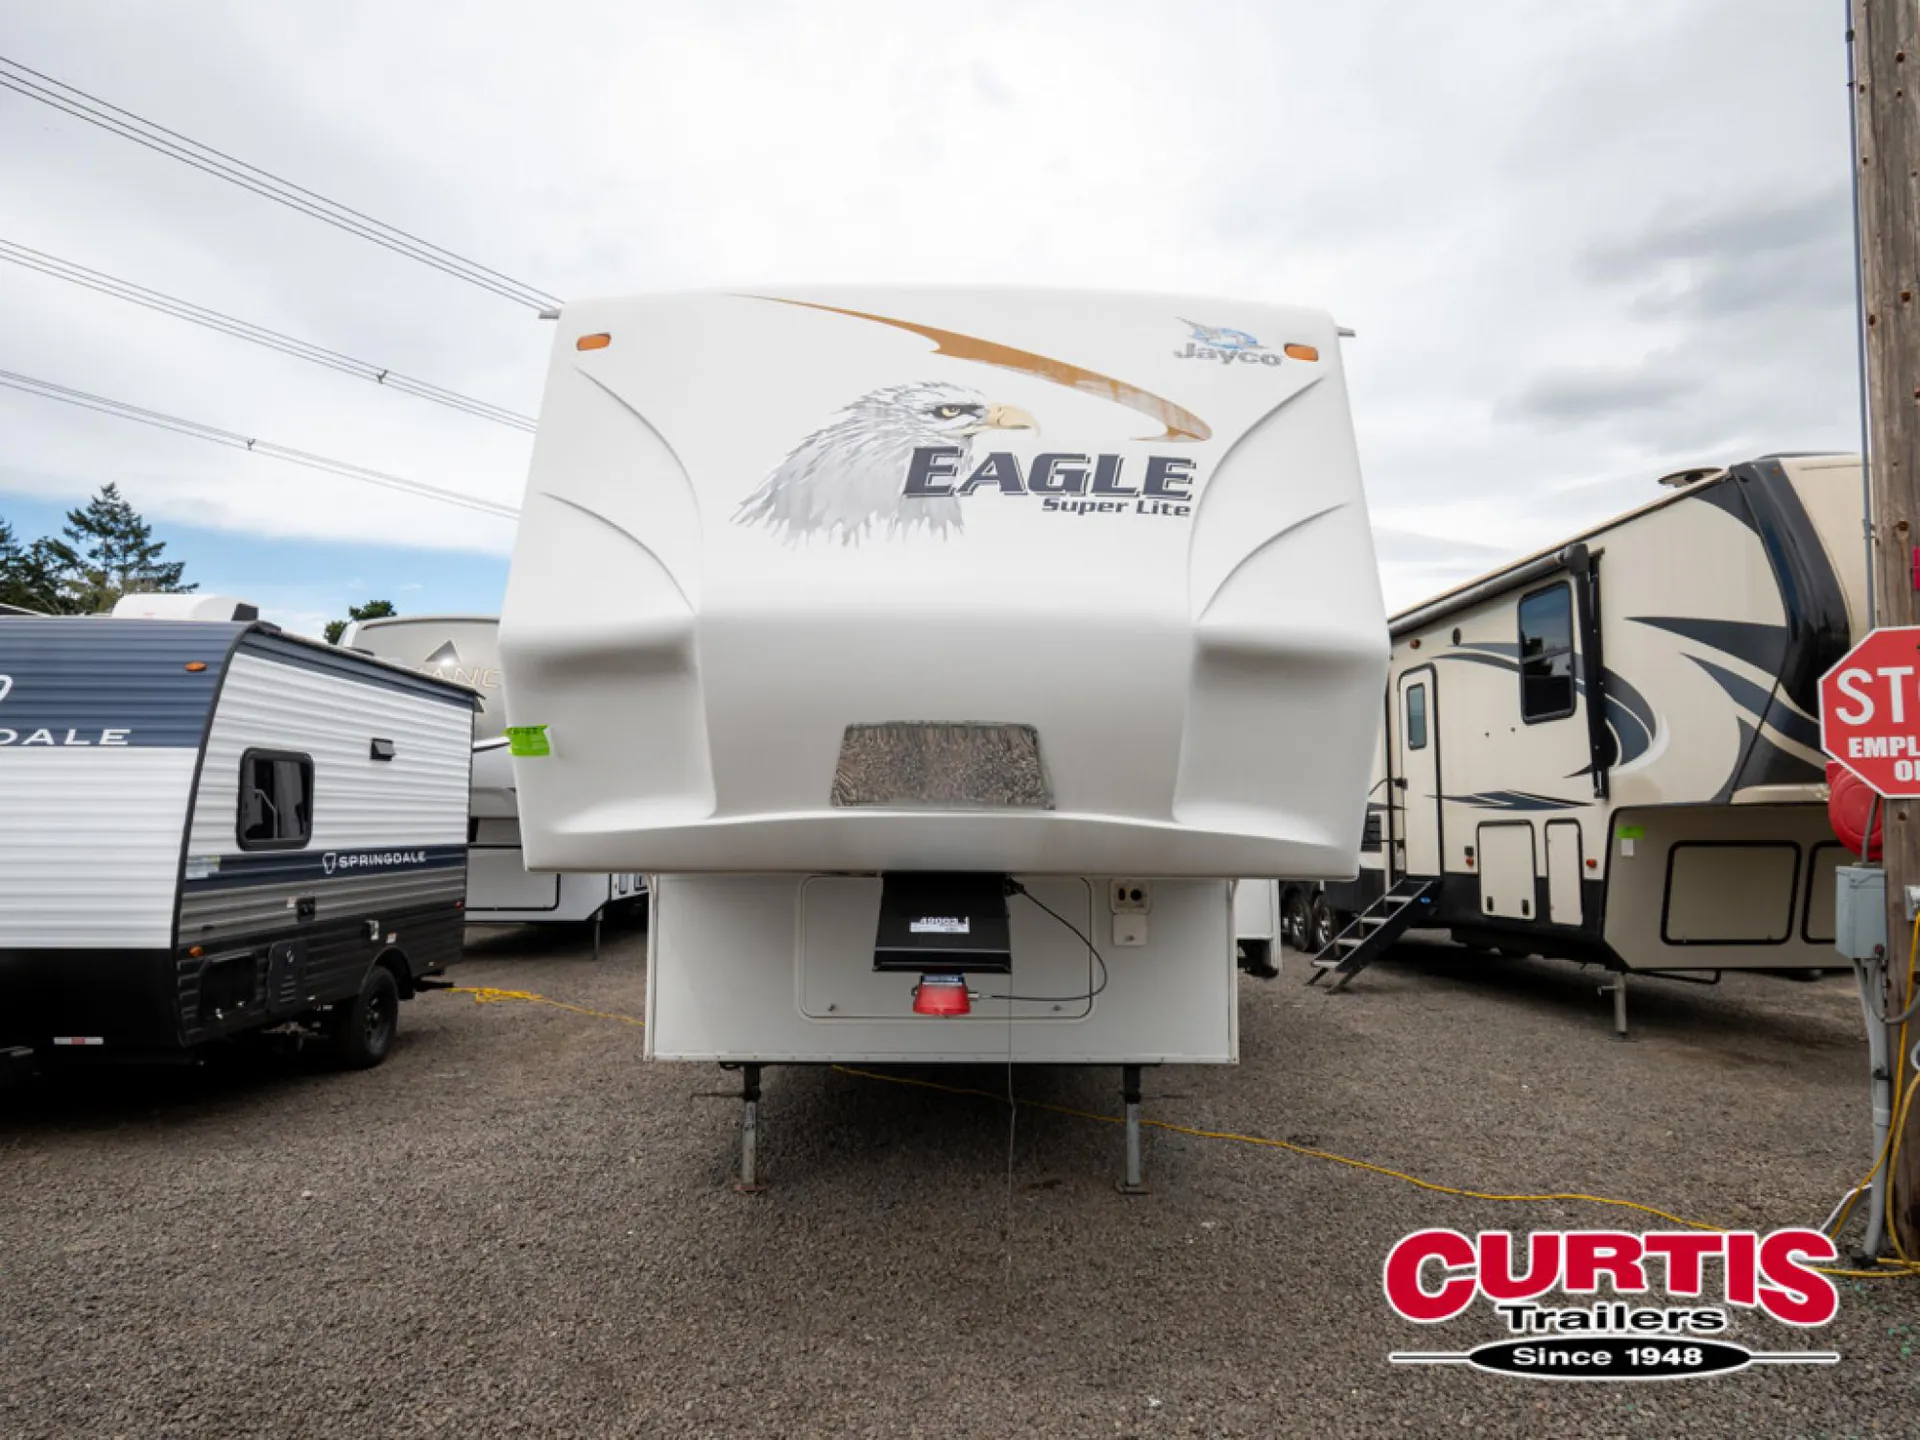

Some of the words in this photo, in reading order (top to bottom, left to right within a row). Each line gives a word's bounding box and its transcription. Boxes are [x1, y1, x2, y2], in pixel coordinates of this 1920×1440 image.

[1172, 342, 1283, 366] Jayco
[902, 446, 1197, 501] EAGLE
[1042, 498, 1129, 515] Super
[1135, 499, 1191, 517] Lite
[1835, 665, 1920, 726] ST
[338, 850, 427, 869] SPRINGDALE
